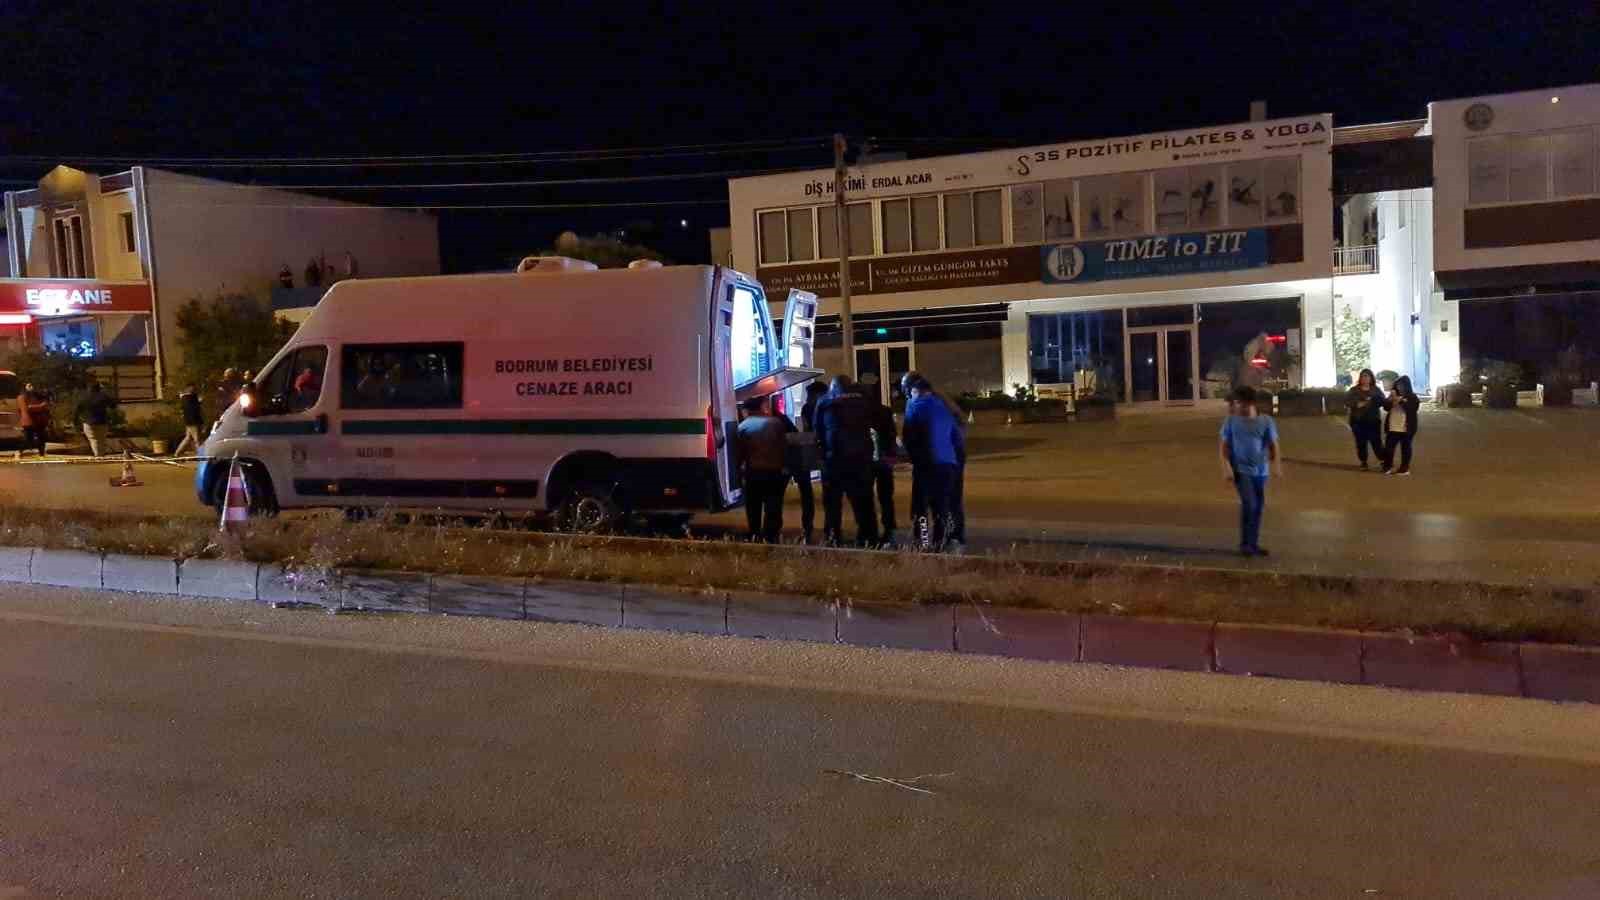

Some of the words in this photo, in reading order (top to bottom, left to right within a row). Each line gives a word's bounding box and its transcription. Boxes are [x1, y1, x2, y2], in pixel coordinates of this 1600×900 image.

[1035, 150, 1060, 162] 3S
[1066, 139, 1144, 159] POZİTİF
[1151, 131, 1237, 152] PİLATES
[1241, 129, 1255, 141] &
[1265, 121, 1326, 137] YOGA
[804, 179, 823, 198] DİŞ
[826, 174, 866, 194] HKİMİ
[872, 176, 903, 189] ERDAL
[906, 173, 933, 186] ACAR
[1104, 237, 1169, 262] TIME
[1174, 238, 1198, 257] to
[1203, 231, 1247, 255] FIT
[25, 288, 113, 305] EANE
[495, 359, 559, 373] BODRUM
[563, 354, 653, 373] BELEDİYESİ
[516, 381, 578, 396] CENAZE
[583, 381, 633, 395] ARACI
